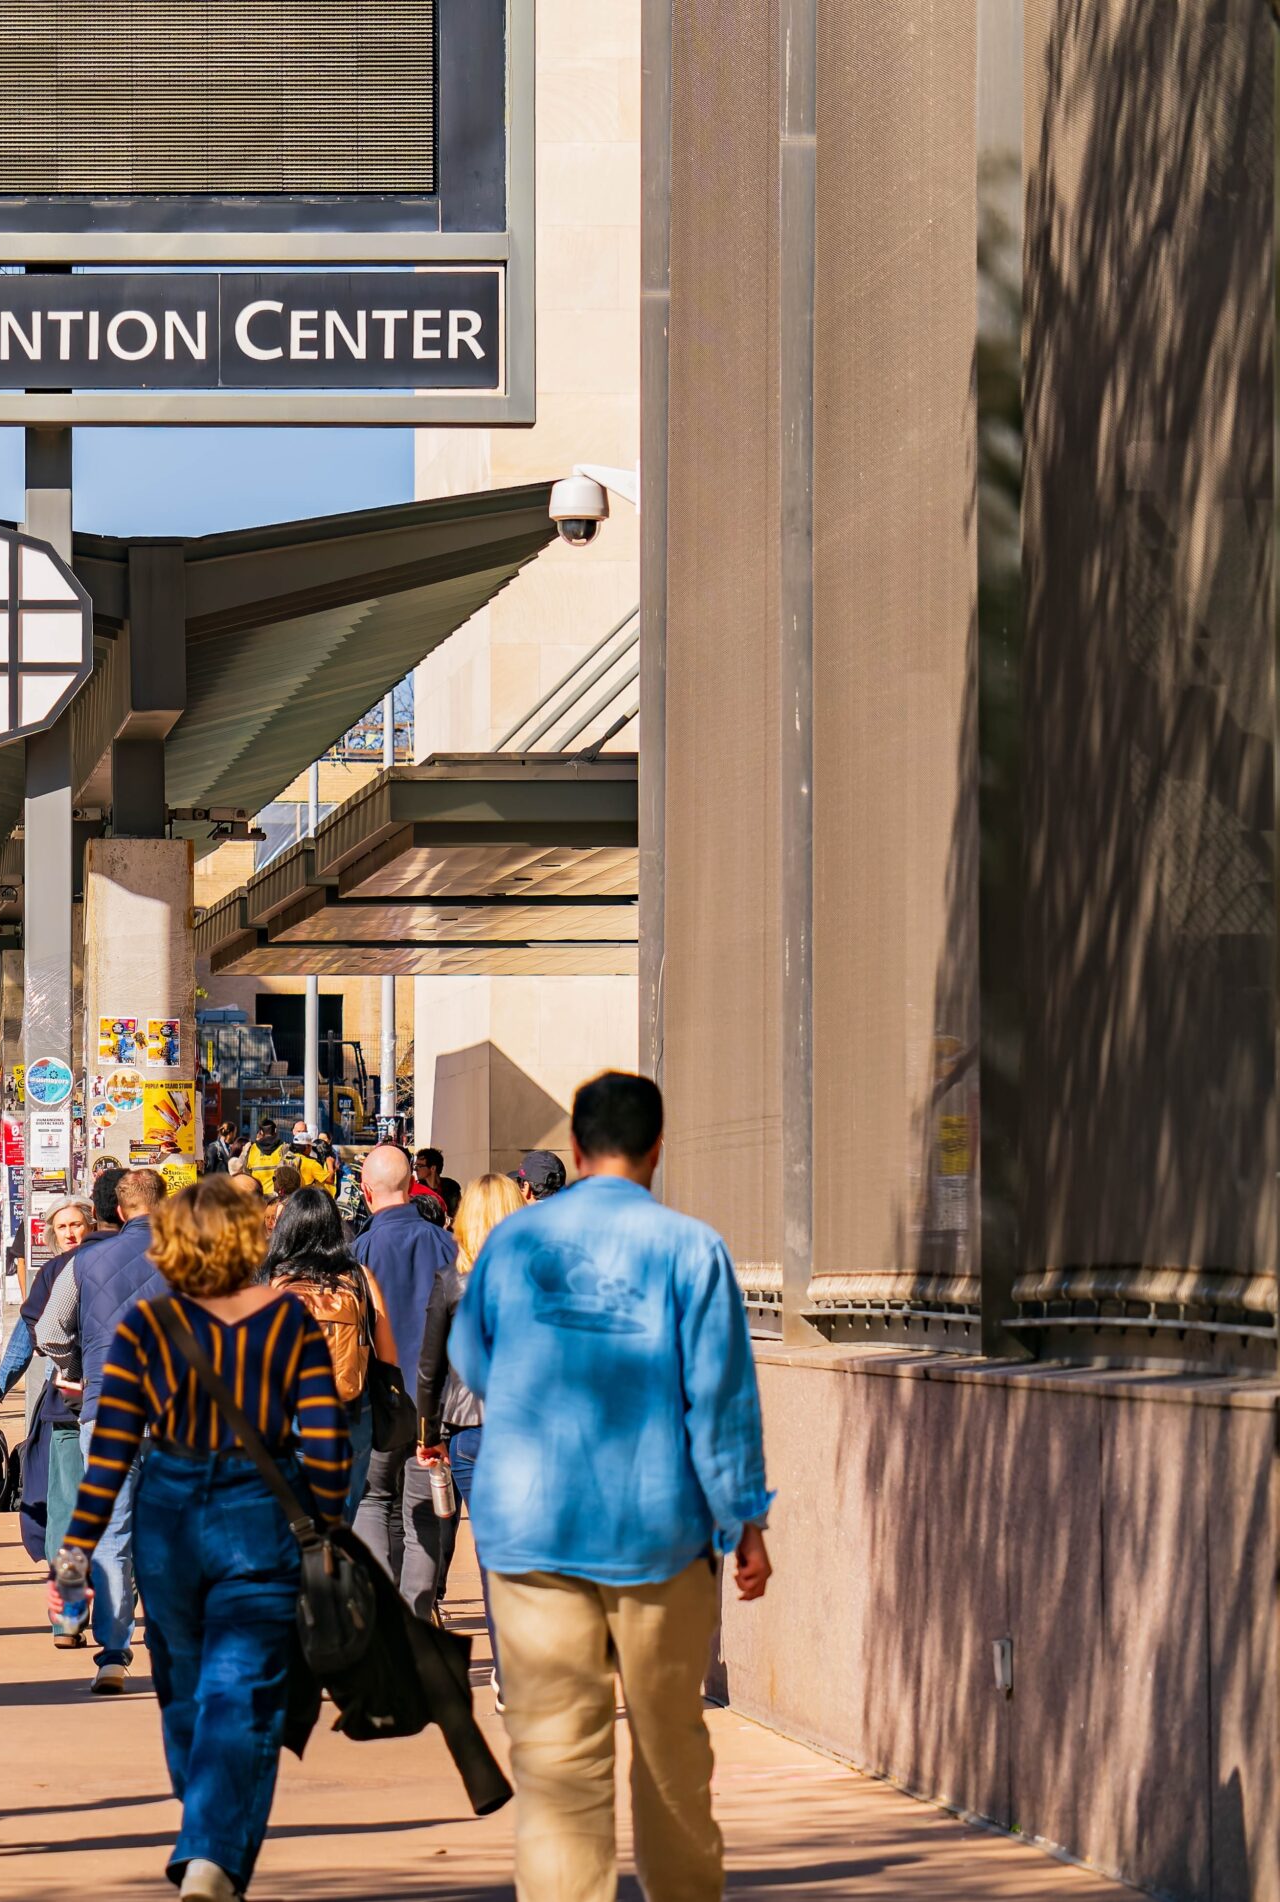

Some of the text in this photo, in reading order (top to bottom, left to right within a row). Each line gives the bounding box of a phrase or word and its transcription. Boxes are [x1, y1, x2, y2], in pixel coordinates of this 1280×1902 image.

[234, 300, 486, 361] CENTER
[109, 1086, 143, 1094] #usmayor
[338, 1099, 353, 1109] CAT
